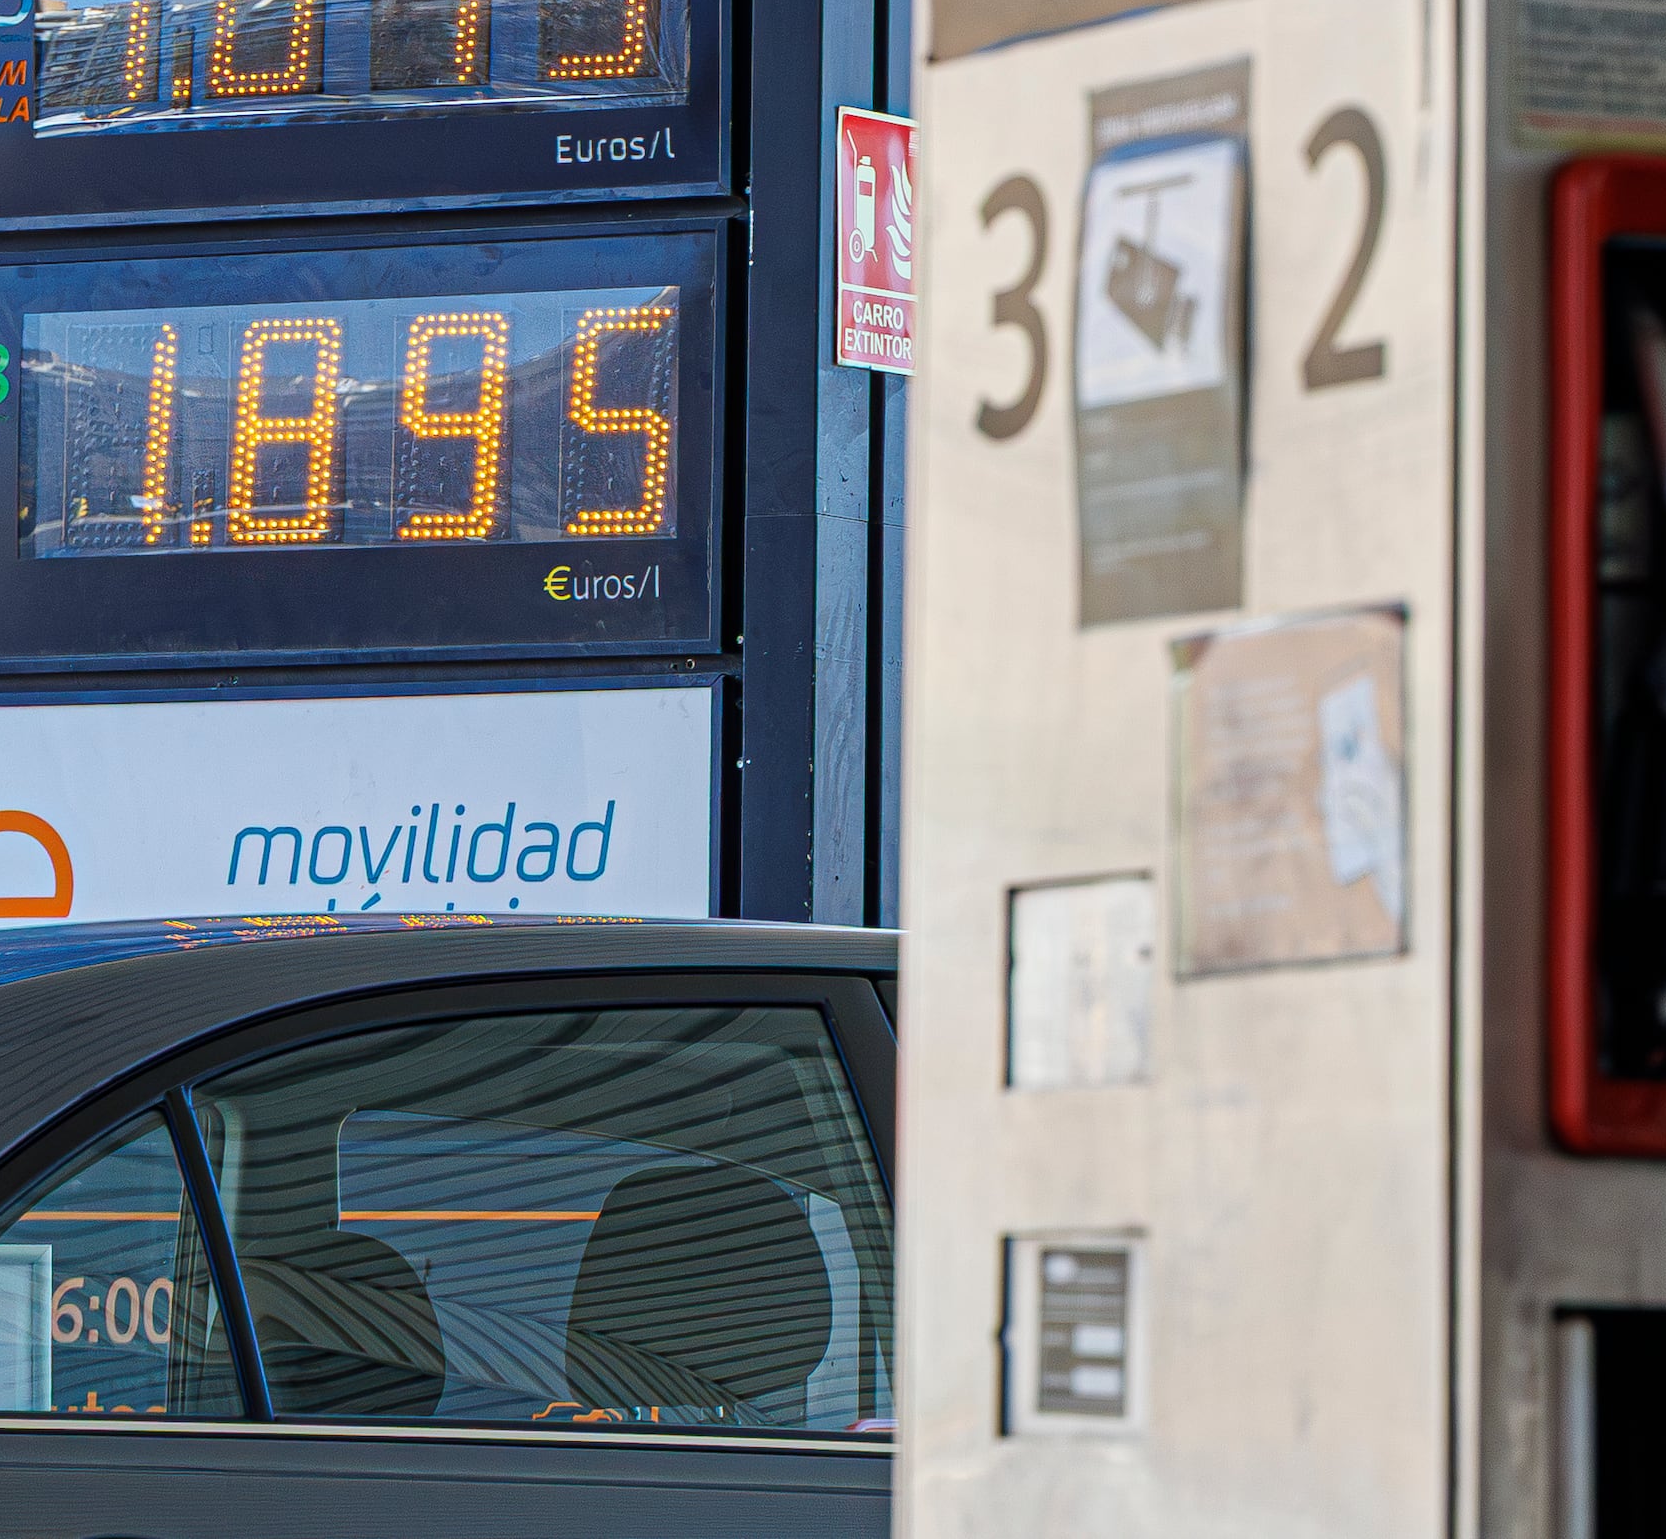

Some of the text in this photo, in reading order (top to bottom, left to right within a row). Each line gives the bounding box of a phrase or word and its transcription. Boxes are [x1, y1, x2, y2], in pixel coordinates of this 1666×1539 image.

[555, 127, 675, 166] Euros/l
[1301, 103, 1390, 391] 2
[844, 328, 912, 361] EXTINTOR
[852, 300, 904, 330] CARRO
[975, 172, 1051, 442] 3
[143, 307, 672, 548] 1.895
[226, 800, 616, 888] movilidad
